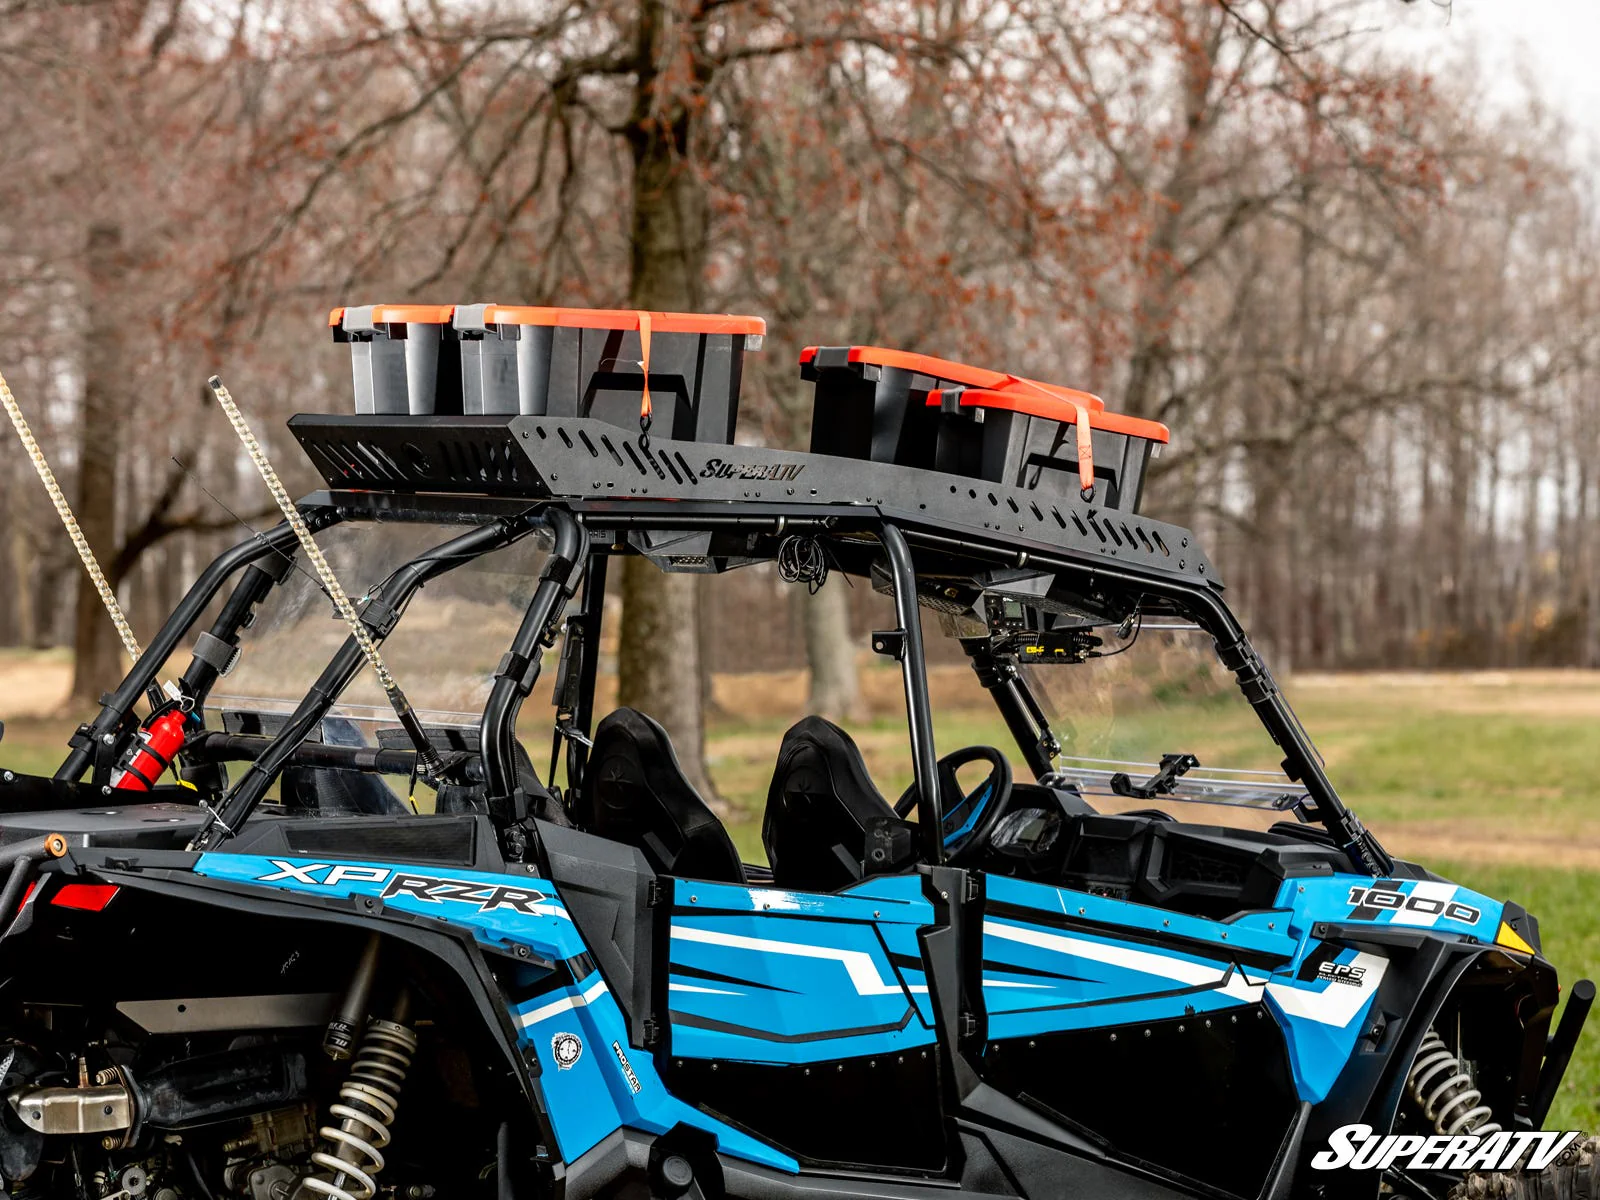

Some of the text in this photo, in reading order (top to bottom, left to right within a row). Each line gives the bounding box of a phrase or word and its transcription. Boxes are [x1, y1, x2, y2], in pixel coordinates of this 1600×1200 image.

[699, 459, 805, 481] SUPERATV
[254, 860, 391, 886] XP
[380, 872, 547, 917] RZR
[1347, 886, 1481, 926] 1000
[1318, 961, 1366, 980] EPS
[612, 1040, 642, 1093] PROSTAR
